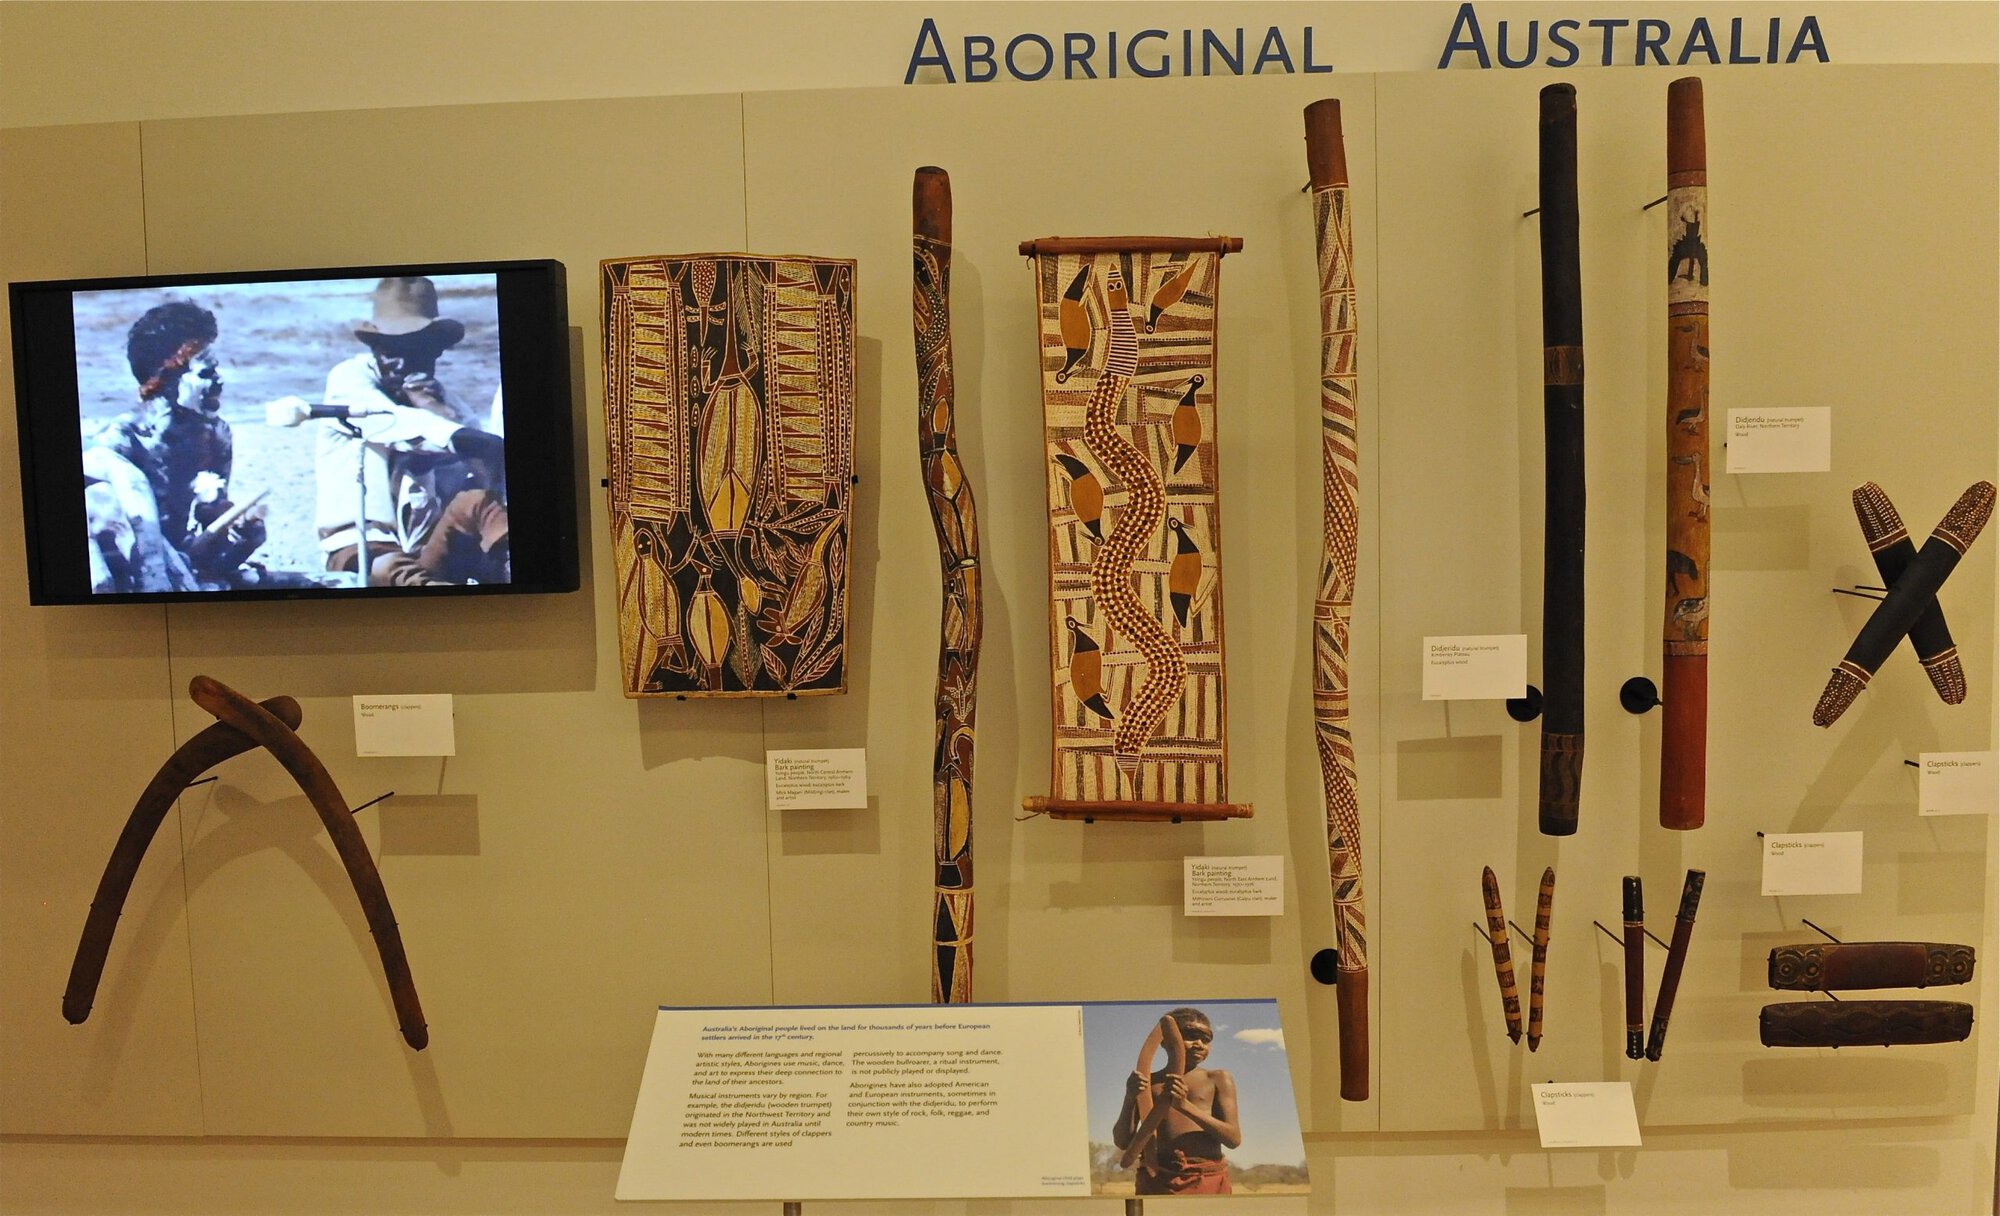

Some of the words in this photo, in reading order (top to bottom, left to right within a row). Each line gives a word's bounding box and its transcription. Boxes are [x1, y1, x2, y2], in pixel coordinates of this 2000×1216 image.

[904, 17, 1333, 85] ABORIGINAL
[1438, 2, 1831, 70] AUSTRALIA
[361, 703, 399, 711] Boomerangs
[1927, 760, 1958, 768] Clapsticks
[1771, 841, 1802, 849] Clapsticks
[775, 1025, 798, 1033] people
[815, 1051, 842, 1059] regional
[853, 1050, 894, 1058] percussively
[721, 1060, 742, 1068] styles,
[775, 1069, 792, 1077] deep
[873, 1068, 900, 1076] publicly
[902, 1068, 924, 1076] played
[850, 1082, 887, 1090] Aborigines
[779, 1092, 787, 1100] by
[687, 1102, 719, 1110] example,
[923, 1100, 956, 1108] didjeridu,
[968, 1099, 998, 1108] perform
[685, 1111, 721, 1120] originated
[882, 1110, 900, 1118] style
[930, 1109, 945, 1117] folk,
[713, 1121, 735, 1129] widely
[737, 1121, 760, 1129] played
[770, 1130, 790, 1138] styles
[801, 1130, 831, 1138] clappers
[714, 1141, 760, 1149] boomerangs
